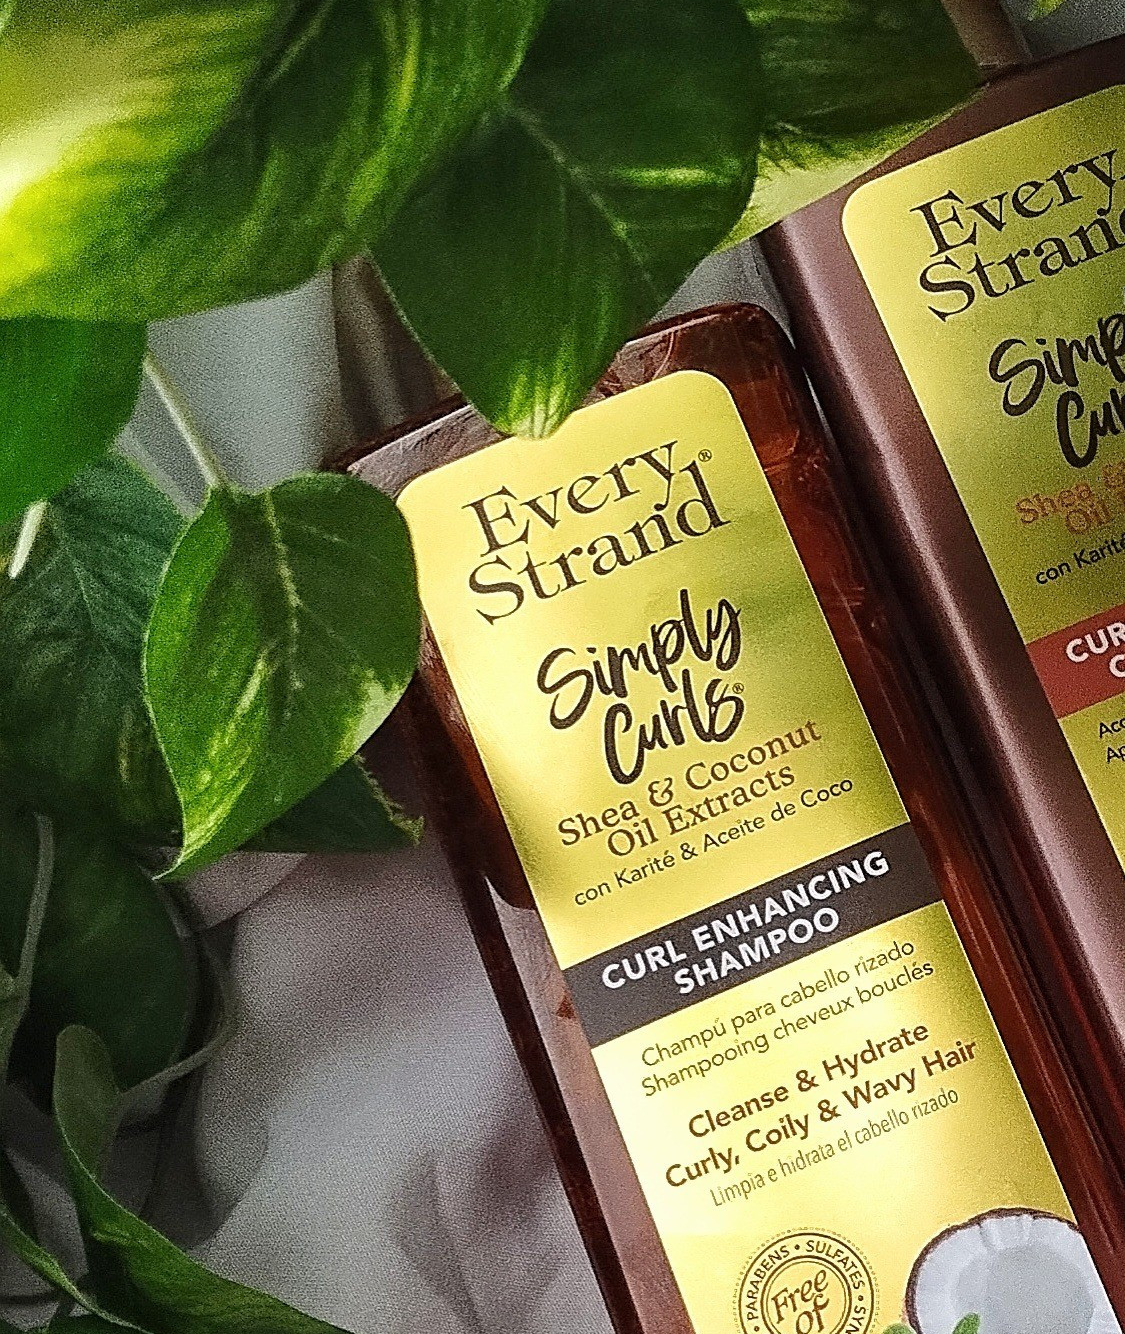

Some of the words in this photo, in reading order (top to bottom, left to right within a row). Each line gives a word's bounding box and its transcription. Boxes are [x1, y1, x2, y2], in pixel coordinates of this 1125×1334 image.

[909, 148, 1118, 258] Every
[461, 440, 678, 558] Every
[1015, 482, 1096, 526] Shea
[1064, 498, 1111, 536] Oil
[1035, 562, 1072, 585] con
[537, 588, 742, 730] Simply
[558, 800, 640, 847] Shea
[648, 777, 675, 808] &
[685, 719, 823, 791] Coconut
[607, 815, 660, 857] Oil
[662, 766, 796, 836] Extracts
[574, 882, 612, 906] con
[614, 850, 676, 889] Karité
[680, 842, 699, 861] &
[703, 815, 766, 852] Aceite
[770, 801, 797, 822] de
[800, 779, 853, 808] Coco
[602, 940, 687, 989] CURL
[692, 851, 890, 952] ENHANCING
[674, 907, 840, 994] SHAMPOO
[641, 1017, 727, 1067] Champú
[731, 1002, 776, 1035] para
[780, 968, 850, 1008] cabello
[854, 941, 915, 976] rizado
[642, 1033, 770, 1097] Shampooing
[773, 997, 855, 1040] cheveux
[856, 961, 934, 1005] bouclés
[665, 1146, 741, 1187] Curly,
[745, 1113, 809, 1152] Coily
[817, 1098, 841, 1122] &
[842, 1067, 916, 1111] Wavy
[921, 1040, 977, 1077] Hair
[688, 1084, 790, 1138] Cleanse
[795, 1069, 819, 1093] &
[822, 1024, 930, 1081] Hydrate
[709, 1170, 766, 1207] Limpia
[767, 1166, 778, 1183] e
[778, 1142, 835, 1177] hidrata
[837, 1130, 850, 1153] el
[854, 1108, 909, 1145] cabello
[911, 1087, 959, 1120] rizado
[746, 1245, 790, 1321] PARABENS
[771, 1269, 828, 1324] Free
[805, 1239, 865, 1290] SULFATES
